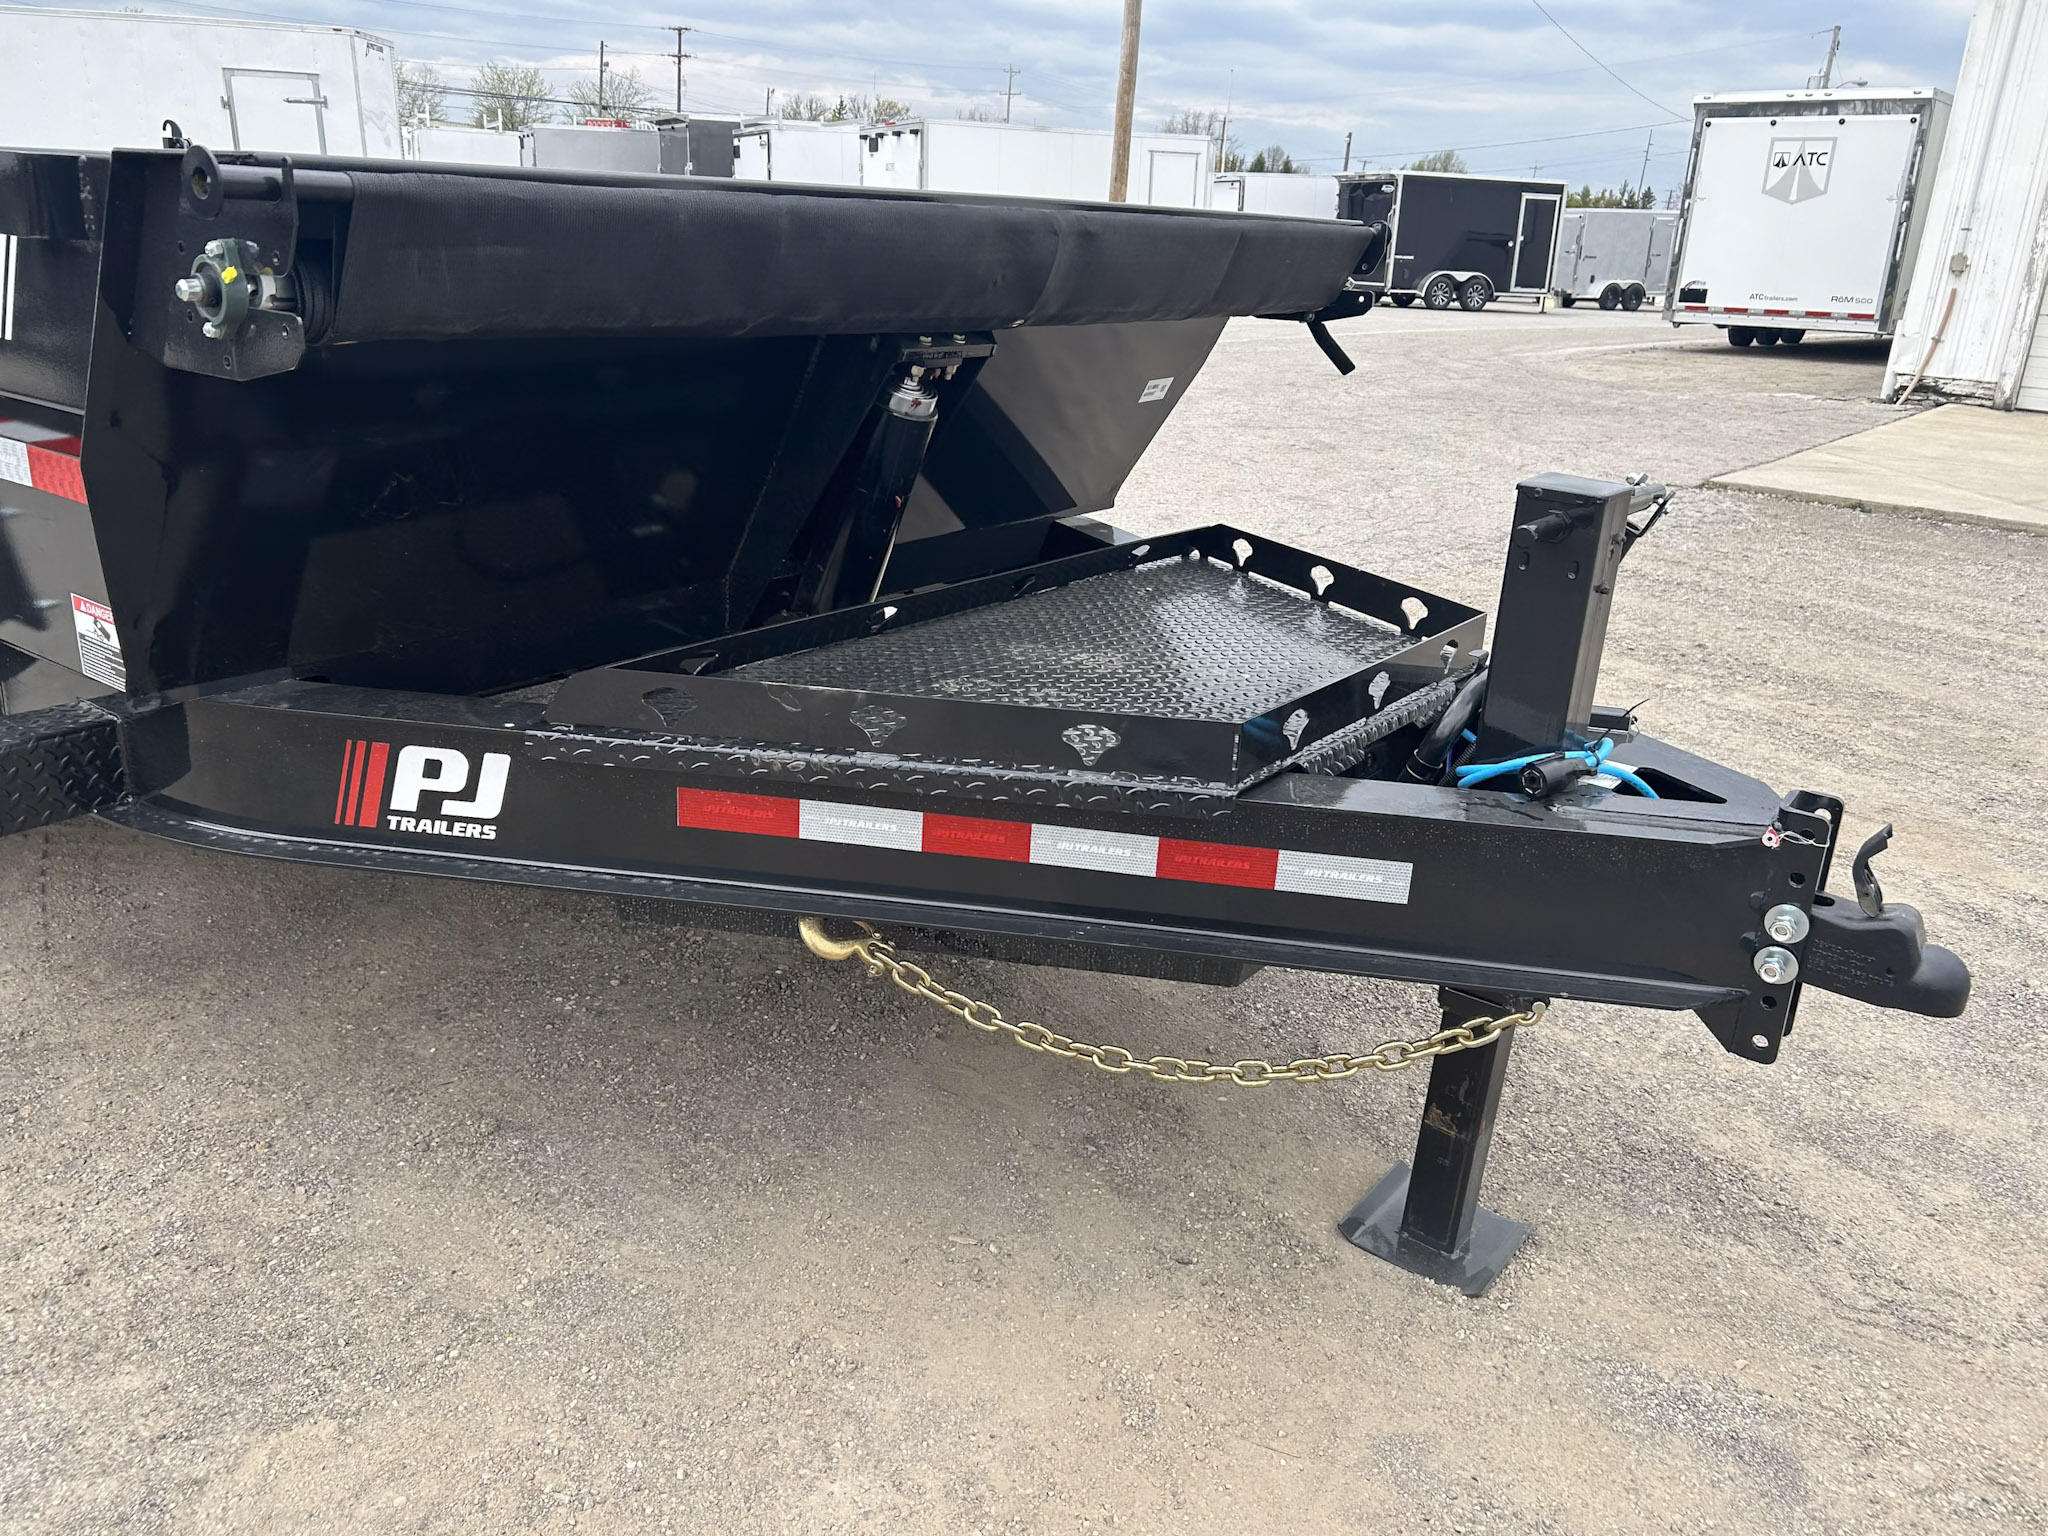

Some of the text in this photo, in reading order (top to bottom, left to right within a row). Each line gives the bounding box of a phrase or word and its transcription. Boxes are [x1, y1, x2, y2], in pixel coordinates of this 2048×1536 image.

[1793, 152, 1828, 166] ATC
[1855, 297, 1873, 305] 500
[389, 745, 511, 819] PJ
[386, 815, 497, 839] TRAILERS
